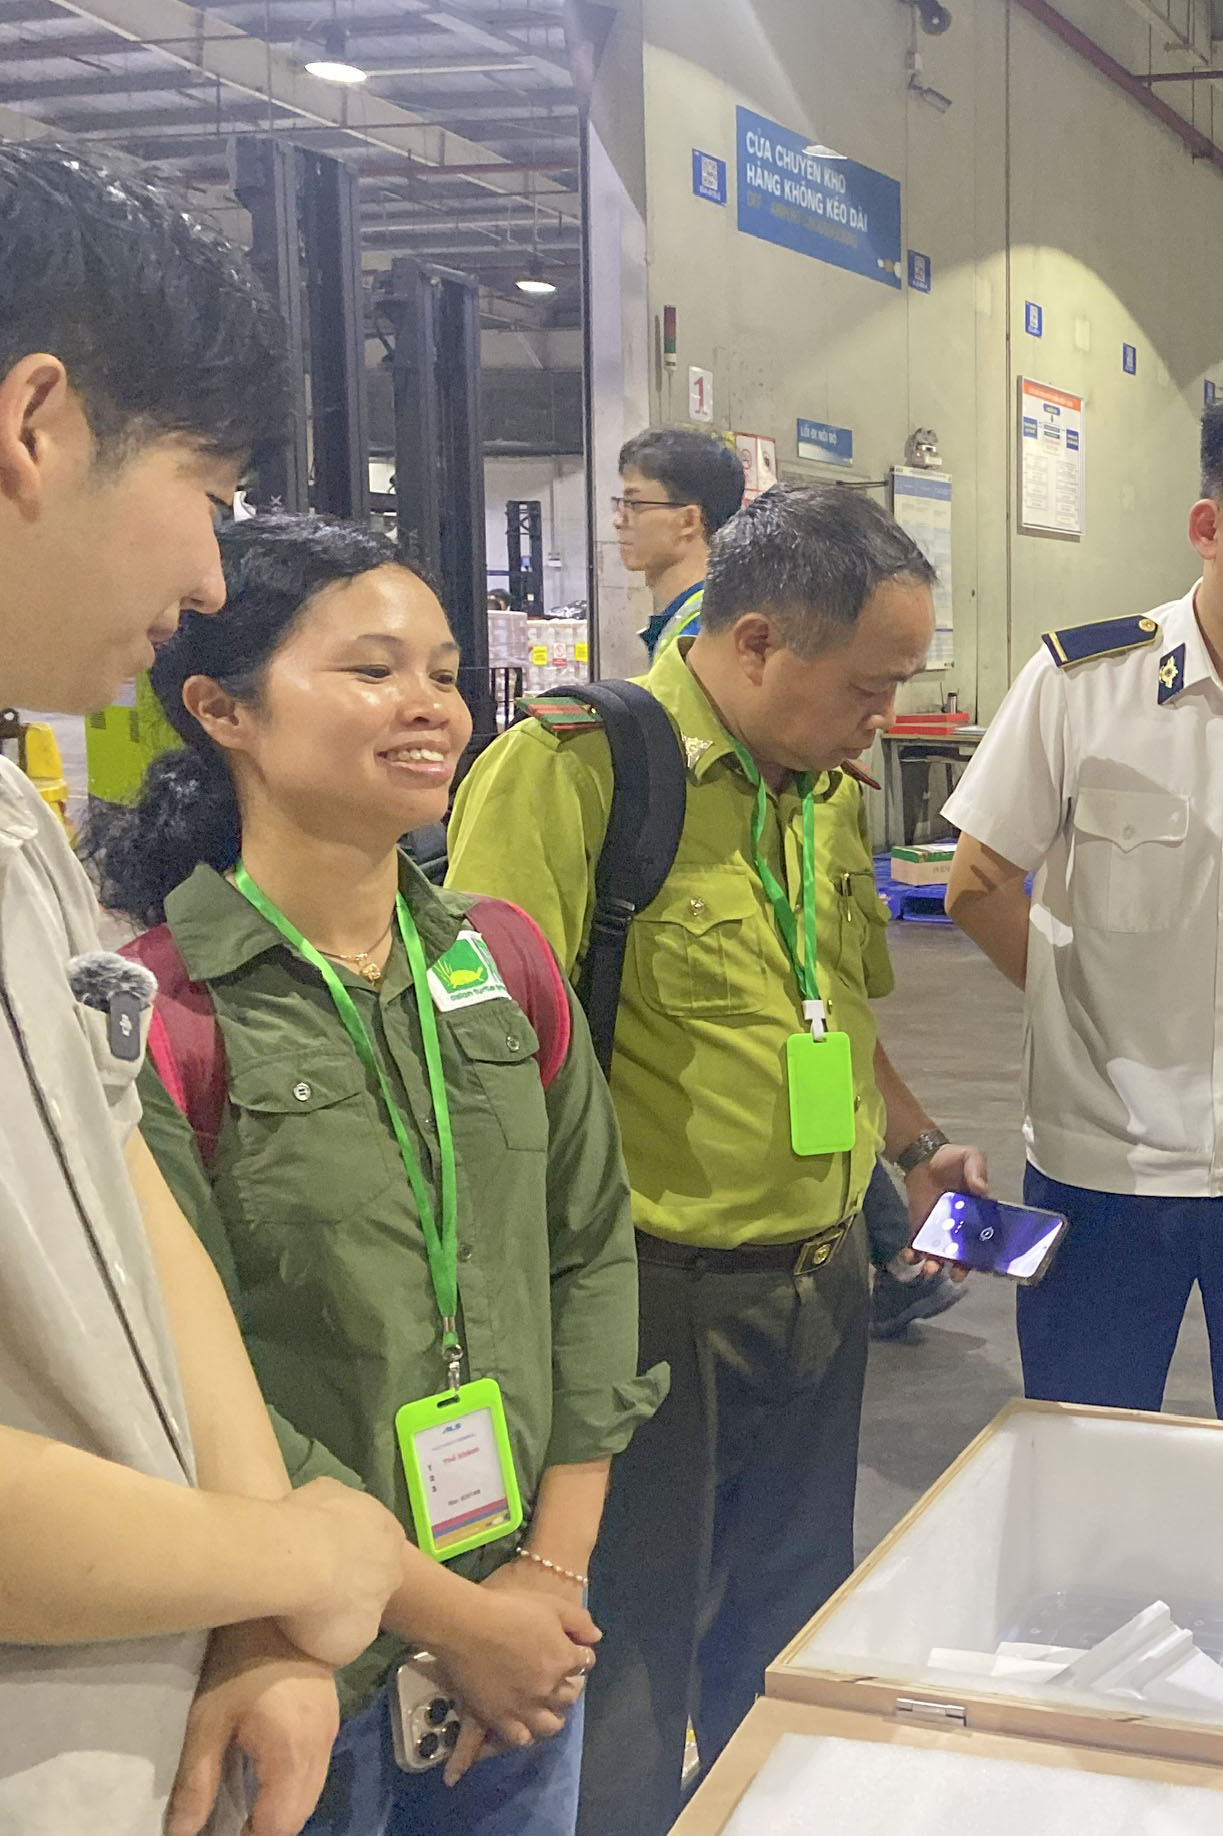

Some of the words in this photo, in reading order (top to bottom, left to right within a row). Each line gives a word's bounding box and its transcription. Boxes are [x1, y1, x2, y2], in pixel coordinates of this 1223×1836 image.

[784, 179, 824, 214] KHÔNG
[824, 166, 846, 194] KHO
[693, 376, 708, 415] 1
